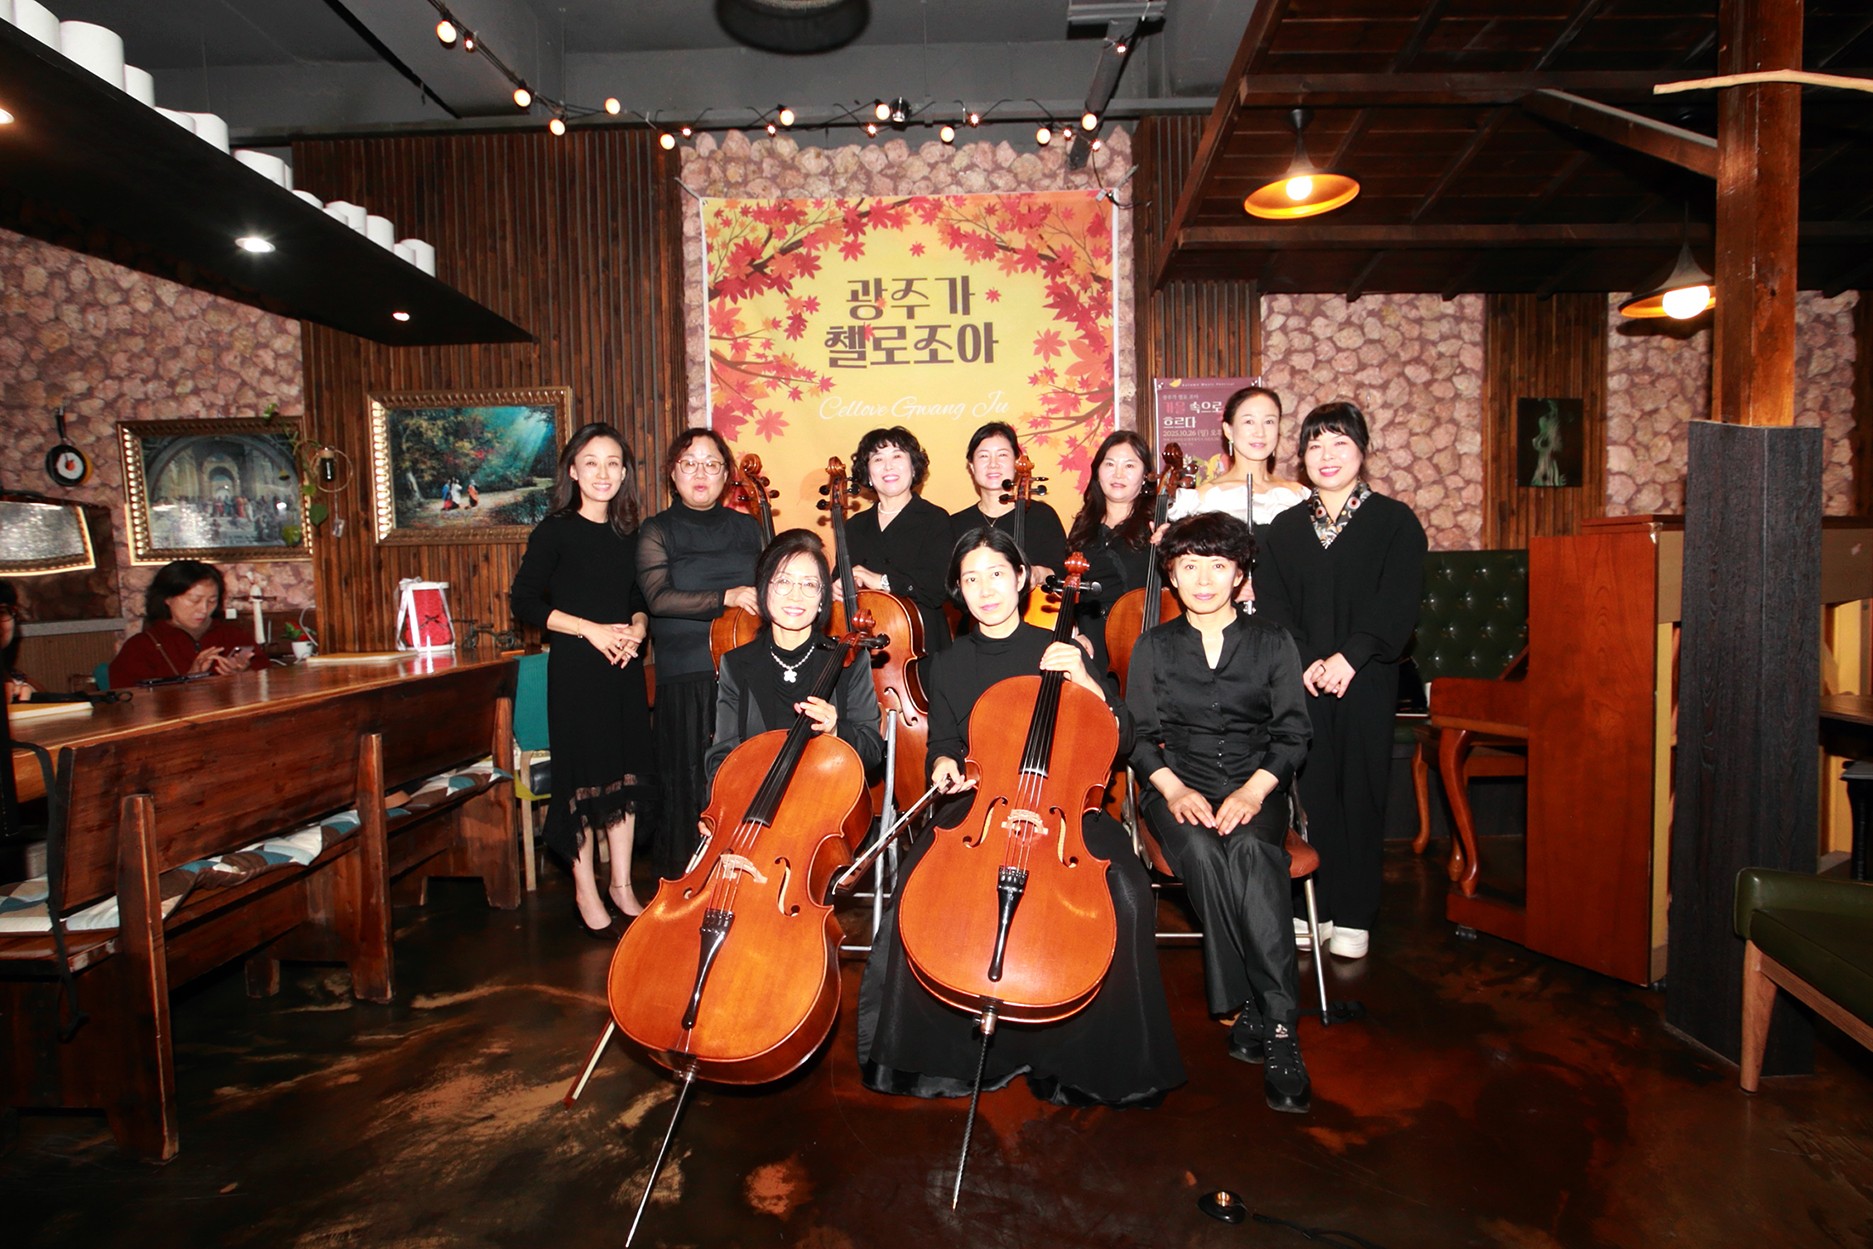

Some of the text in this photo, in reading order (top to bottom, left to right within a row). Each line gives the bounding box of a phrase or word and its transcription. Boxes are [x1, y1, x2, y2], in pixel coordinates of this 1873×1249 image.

[846, 275, 975, 321] 광주가
[824, 322, 999, 369] 첼로조아
[819, 390, 1009, 420] Cellove Gwang Ju
[1164, 401, 1222, 414] 가을 속으로
[1162, 416, 1196, 429] 흐르다
